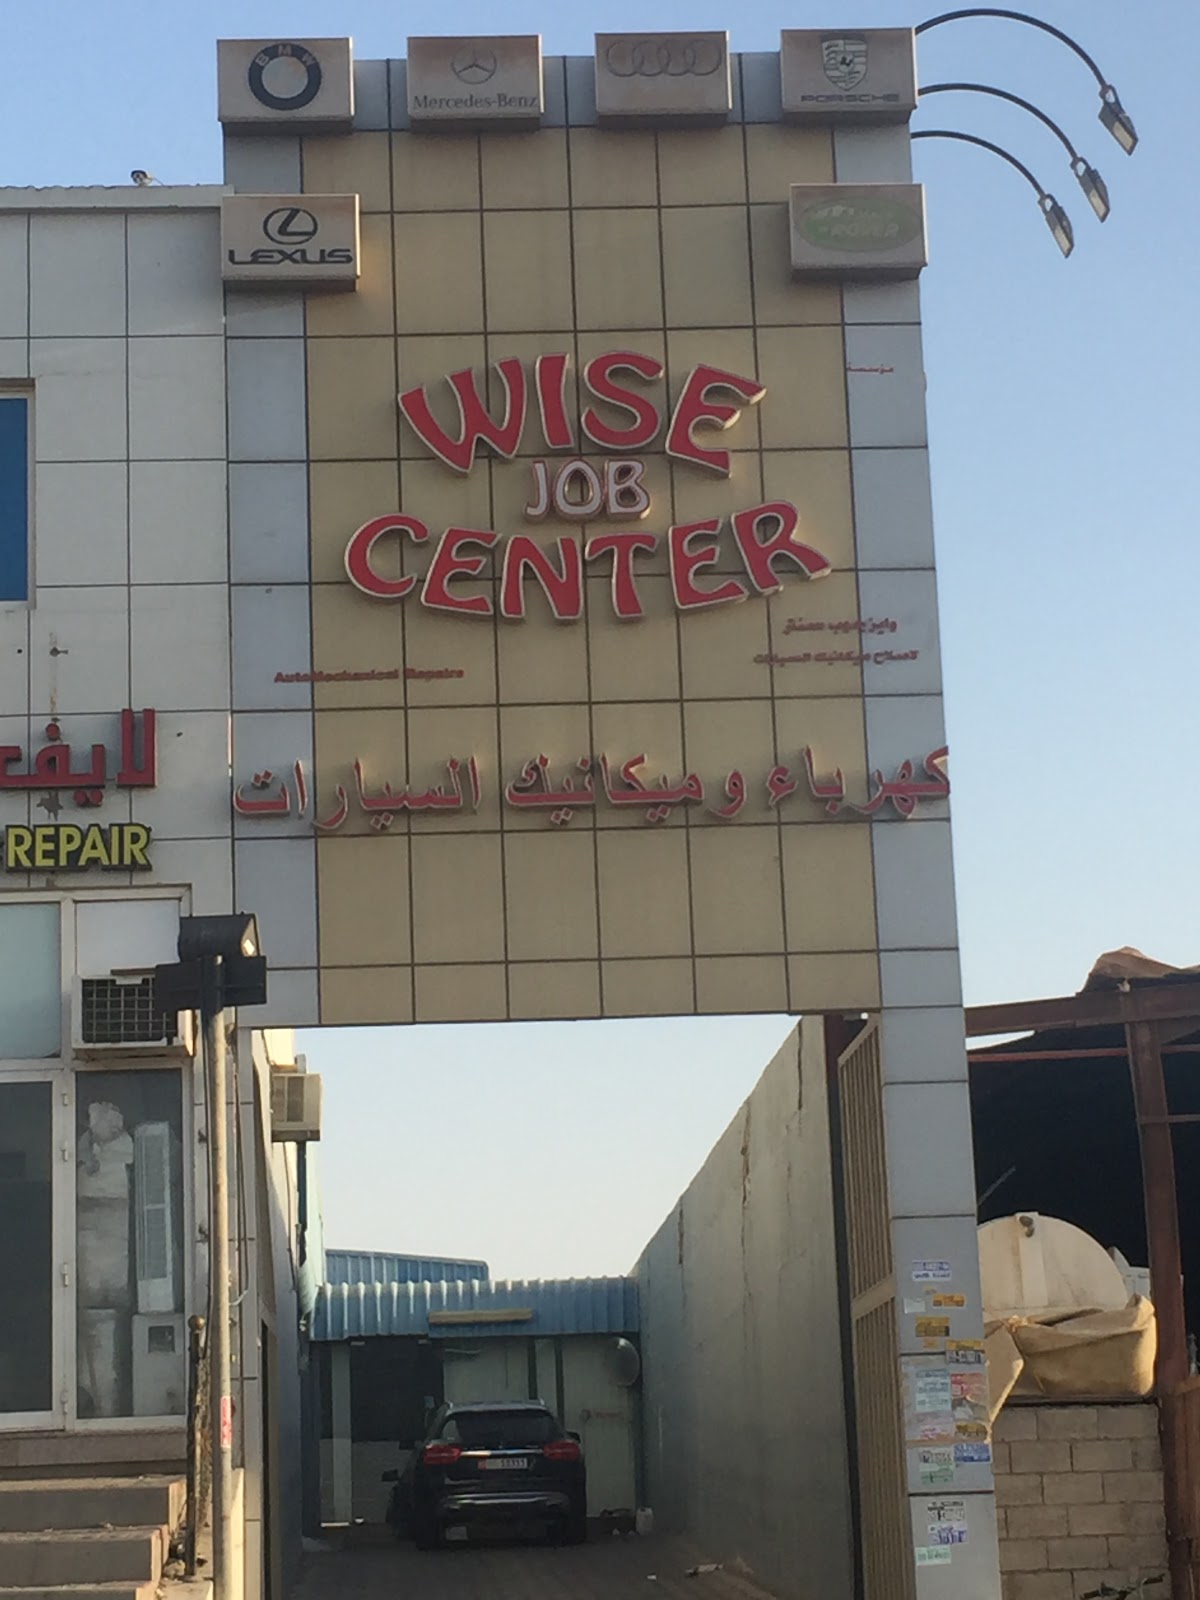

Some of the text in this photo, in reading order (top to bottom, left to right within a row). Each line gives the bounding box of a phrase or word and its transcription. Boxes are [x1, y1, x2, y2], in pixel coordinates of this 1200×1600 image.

[252, 43, 319, 68] BMW
[413, 93, 538, 110] Mercedes-Benz
[800, 93, 900, 104] PORSCHE
[228, 248, 353, 266] LEXUS
[398, 350, 768, 479] WISE
[523, 457, 651, 523] JOB
[344, 499, 834, 621] CENTER
[233, 754, 482, 830] السيارات
[766, 744, 949, 820] كهرباء
[6, 824, 152, 871] REPAIR
